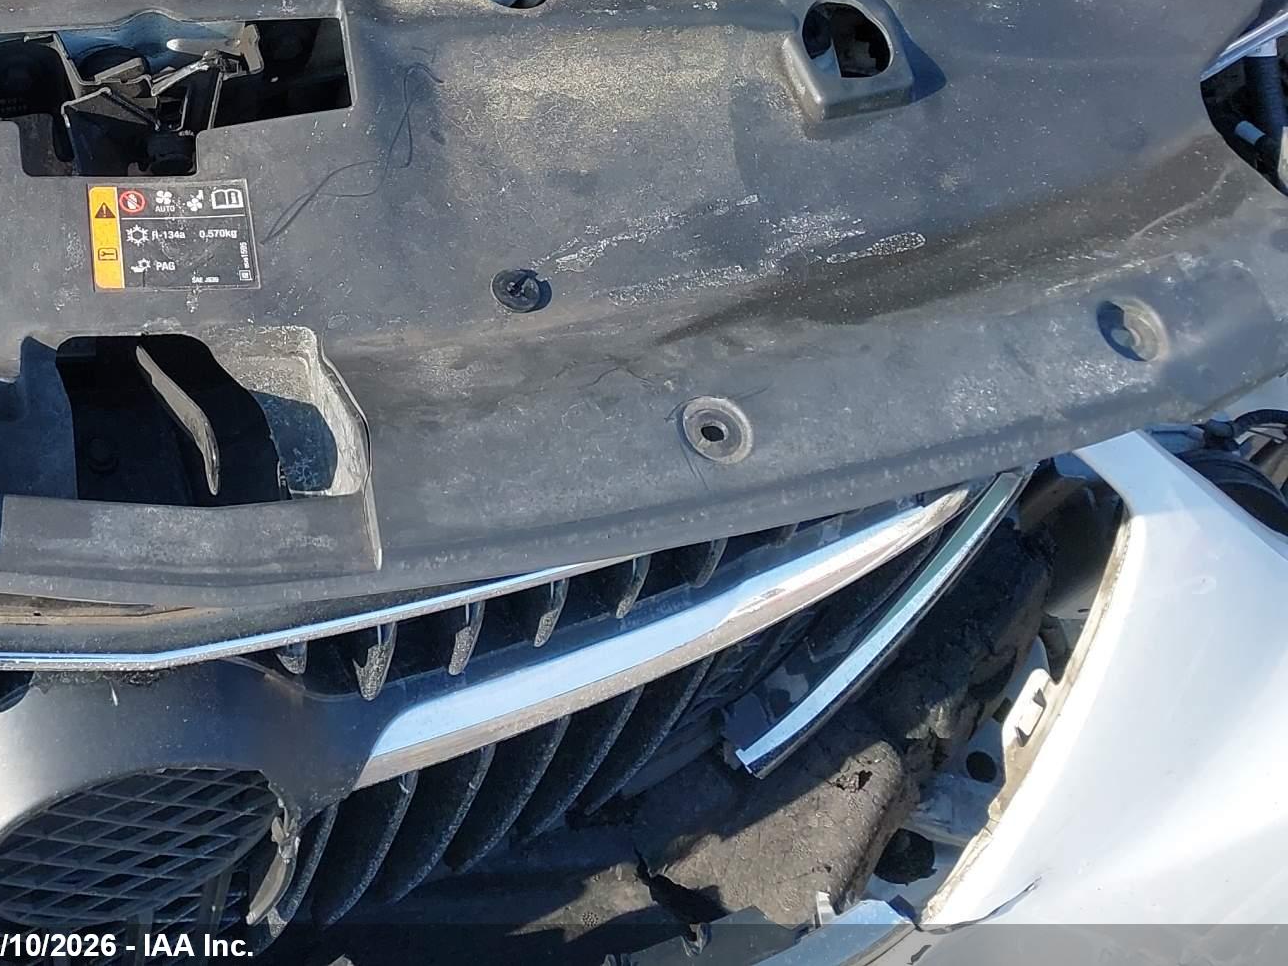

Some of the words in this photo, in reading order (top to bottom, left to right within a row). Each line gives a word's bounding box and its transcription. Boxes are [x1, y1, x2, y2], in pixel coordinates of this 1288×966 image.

[155, 205, 176, 213] AUTO
[151, 230, 186, 240] R-134a
[199, 229, 238, 240] 0.570kg
[156, 261, 176, 271] PAG
